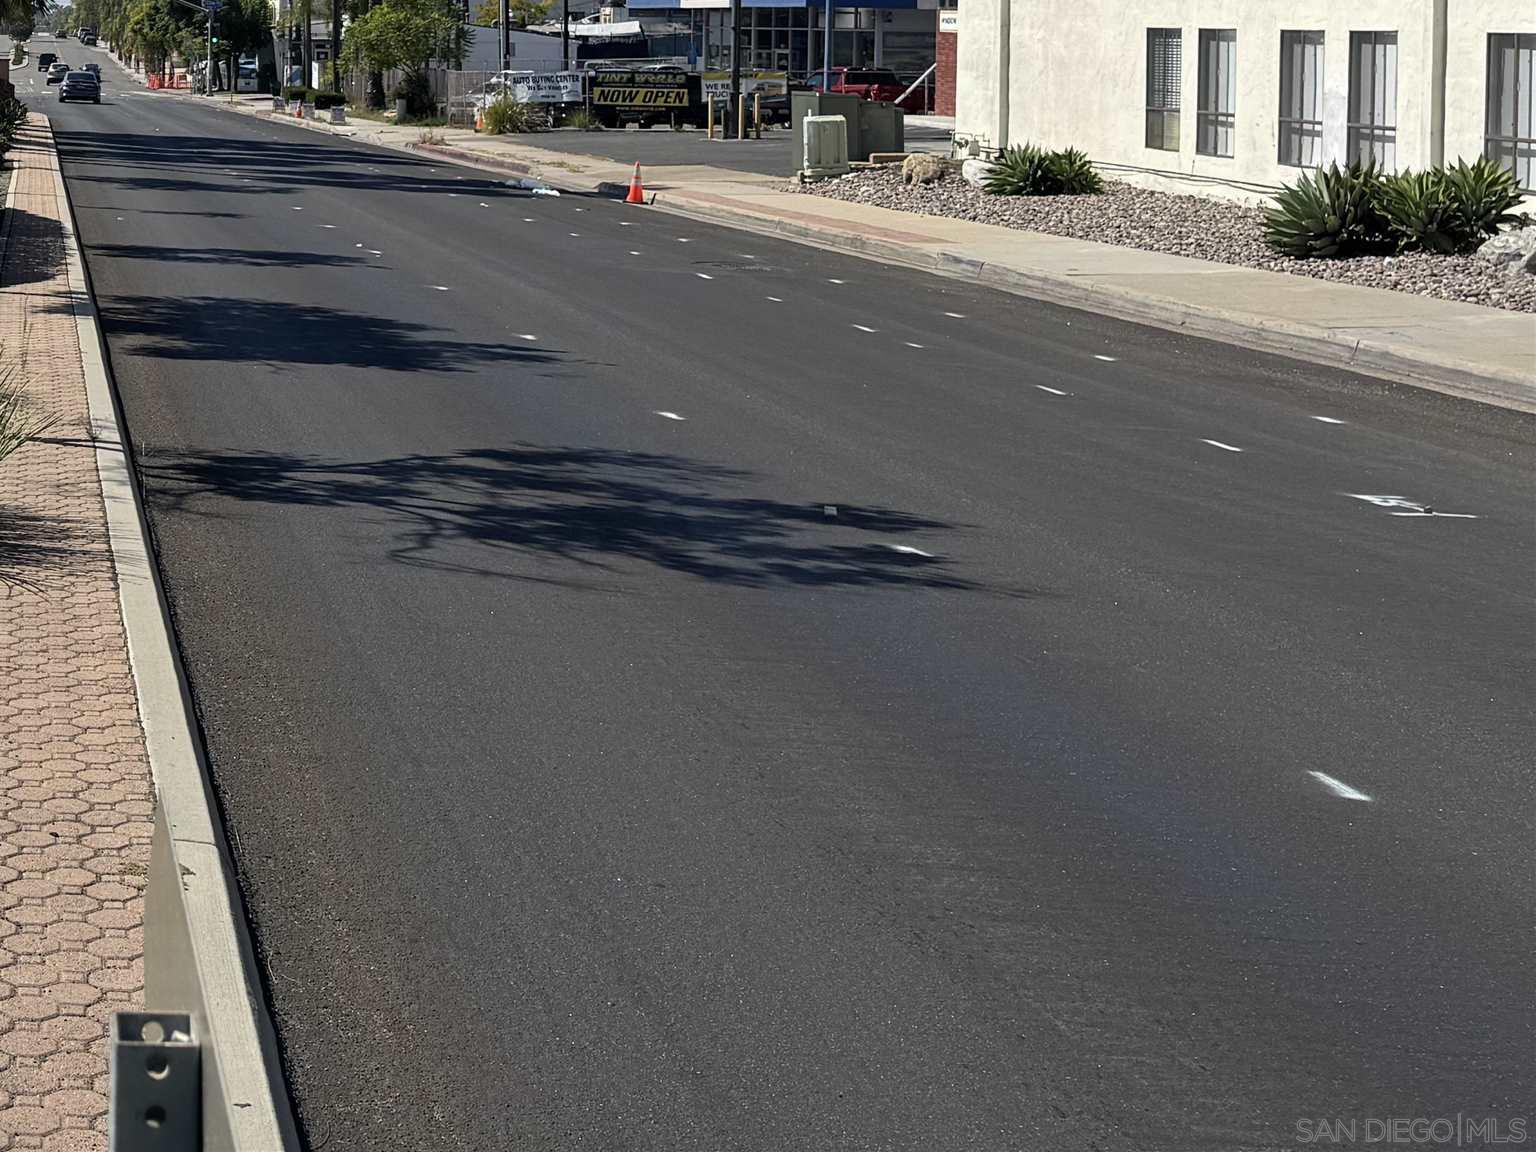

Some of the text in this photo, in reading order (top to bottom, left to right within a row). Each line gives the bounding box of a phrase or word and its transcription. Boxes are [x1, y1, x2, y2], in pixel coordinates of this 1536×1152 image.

[513, 74, 580, 84] AUTO BUYING CENTER
[596, 72, 687, 84] TINT WORLD
[597, 89, 685, 104] NOW OPEN
